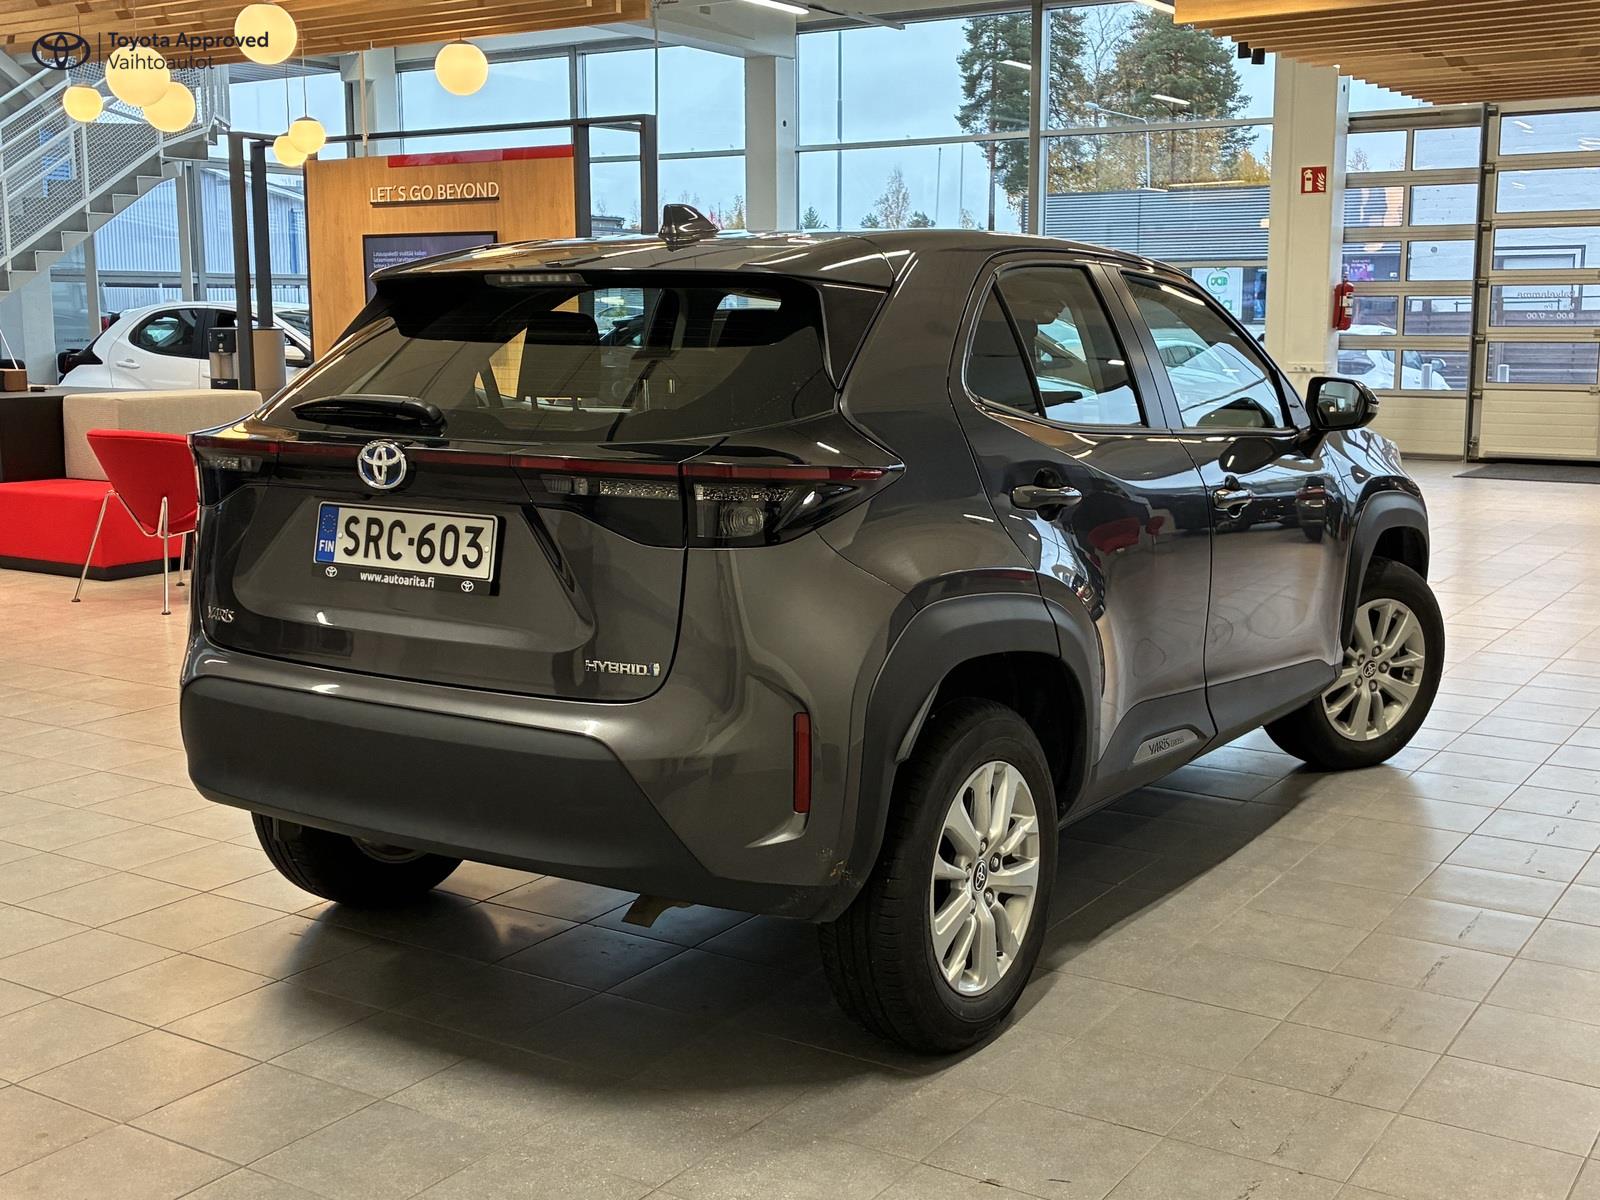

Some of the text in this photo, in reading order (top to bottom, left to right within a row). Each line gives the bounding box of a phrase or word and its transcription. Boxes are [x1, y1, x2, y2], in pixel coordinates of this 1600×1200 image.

[409, 184, 434, 201] GO
[437, 181, 500, 200] BEYOND
[319, 540, 335, 553] FIN
[342, 514, 486, 569] SRC-603
[360, 571, 436, 589] www.autoarita.fi
[584, 659, 648, 676] HYBRID
